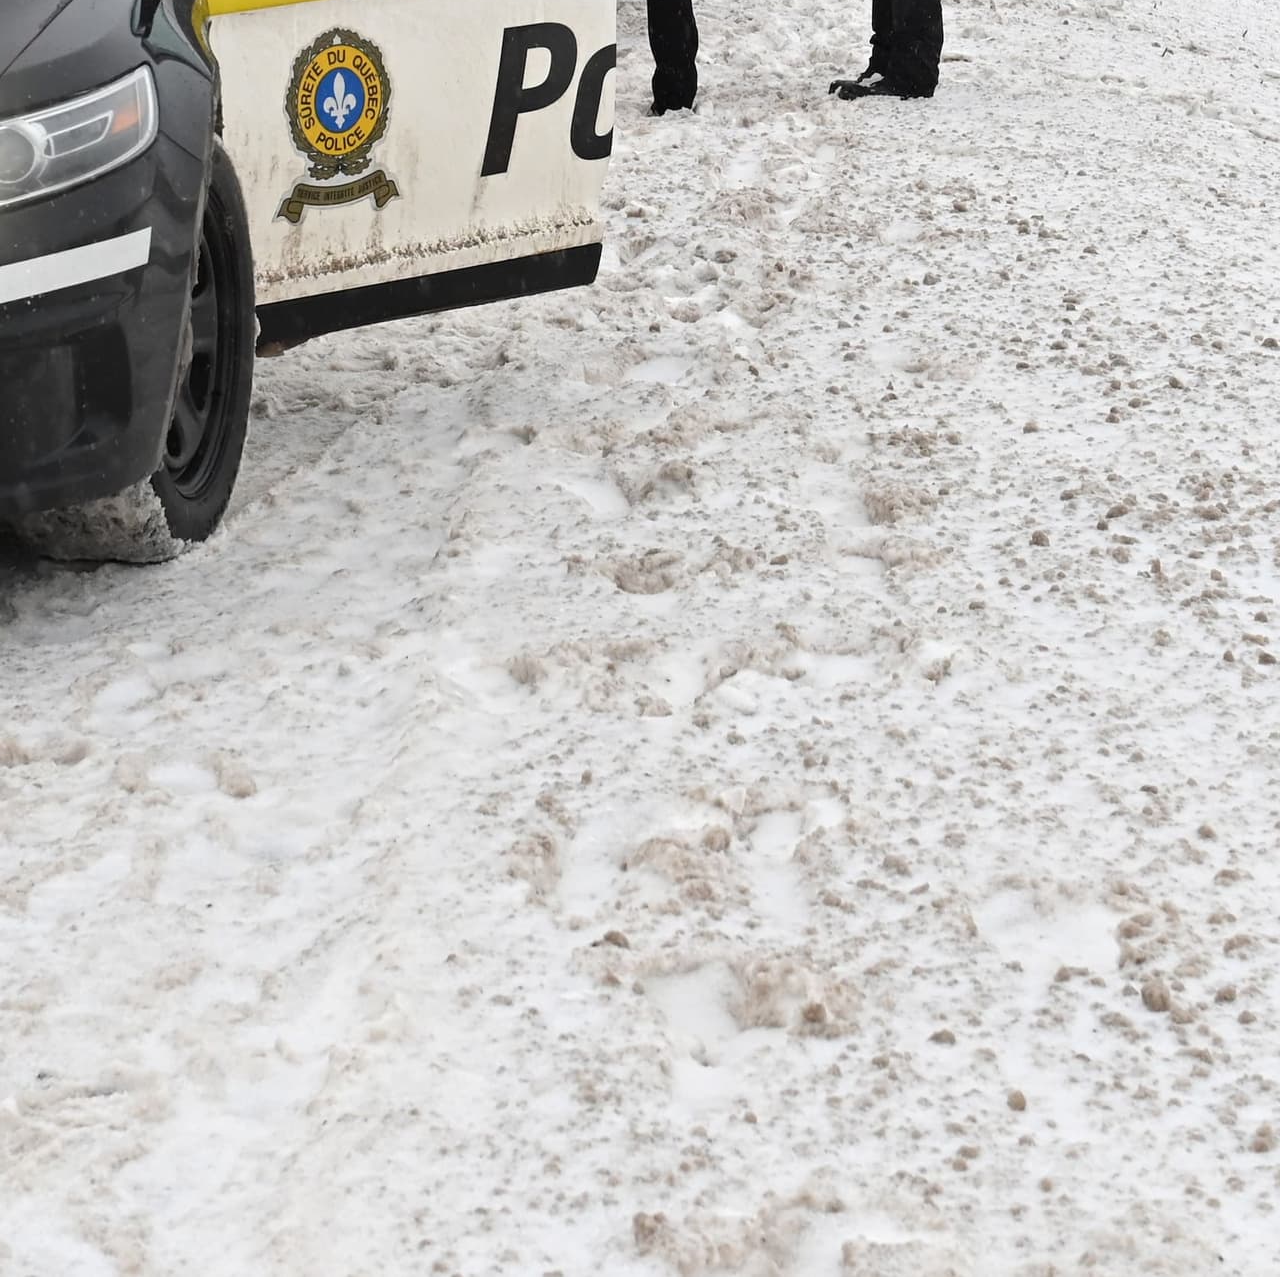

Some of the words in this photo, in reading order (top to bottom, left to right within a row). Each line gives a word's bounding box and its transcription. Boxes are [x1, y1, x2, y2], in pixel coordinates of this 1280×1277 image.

[327, 49, 346, 66] DU
[352, 54, 379, 120] QUÉBEC
[315, 126, 365, 151] POLICE
